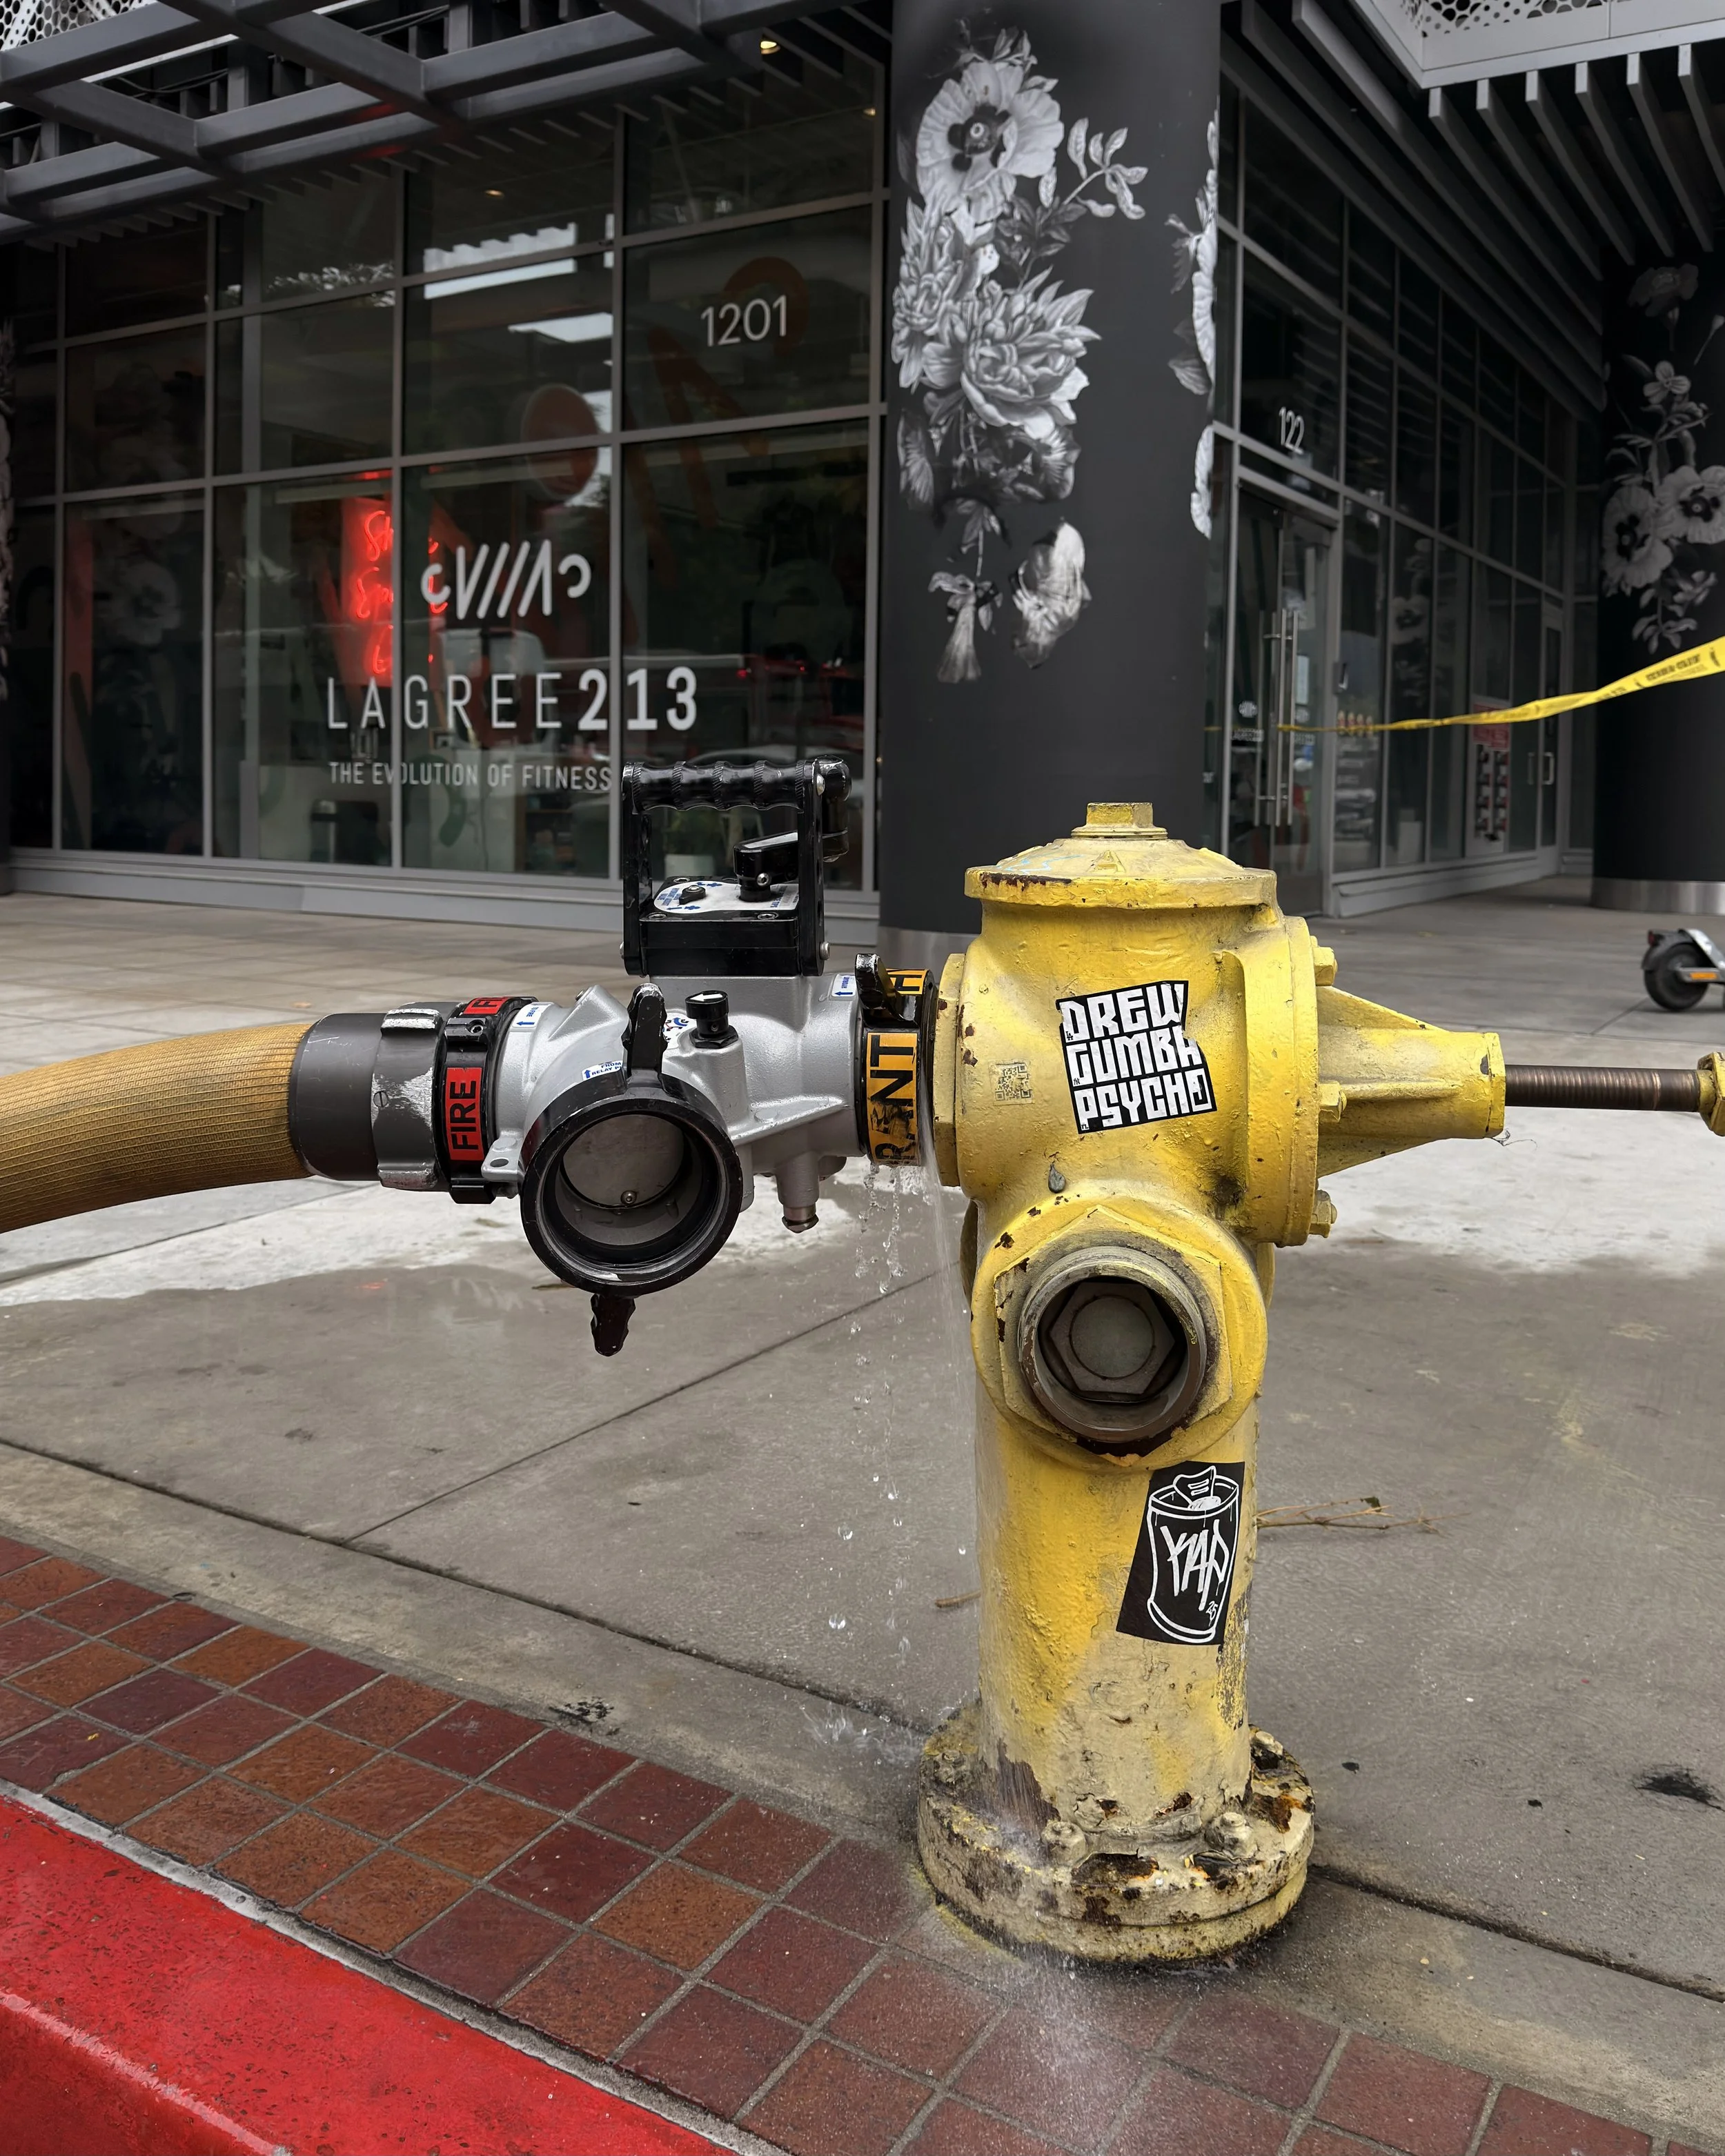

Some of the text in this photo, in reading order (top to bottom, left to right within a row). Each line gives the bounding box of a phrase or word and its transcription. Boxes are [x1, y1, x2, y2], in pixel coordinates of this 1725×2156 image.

[700, 295, 787, 346] 1201
[1279, 406, 1304, 454] 122
[328, 762, 613, 791] THE EVOLUTION OF FITNESS
[1059, 983, 1185, 1042] DREW
[450, 1080, 479, 1151] FIRE
[1074, 1068, 1212, 1131] PSYCHO
